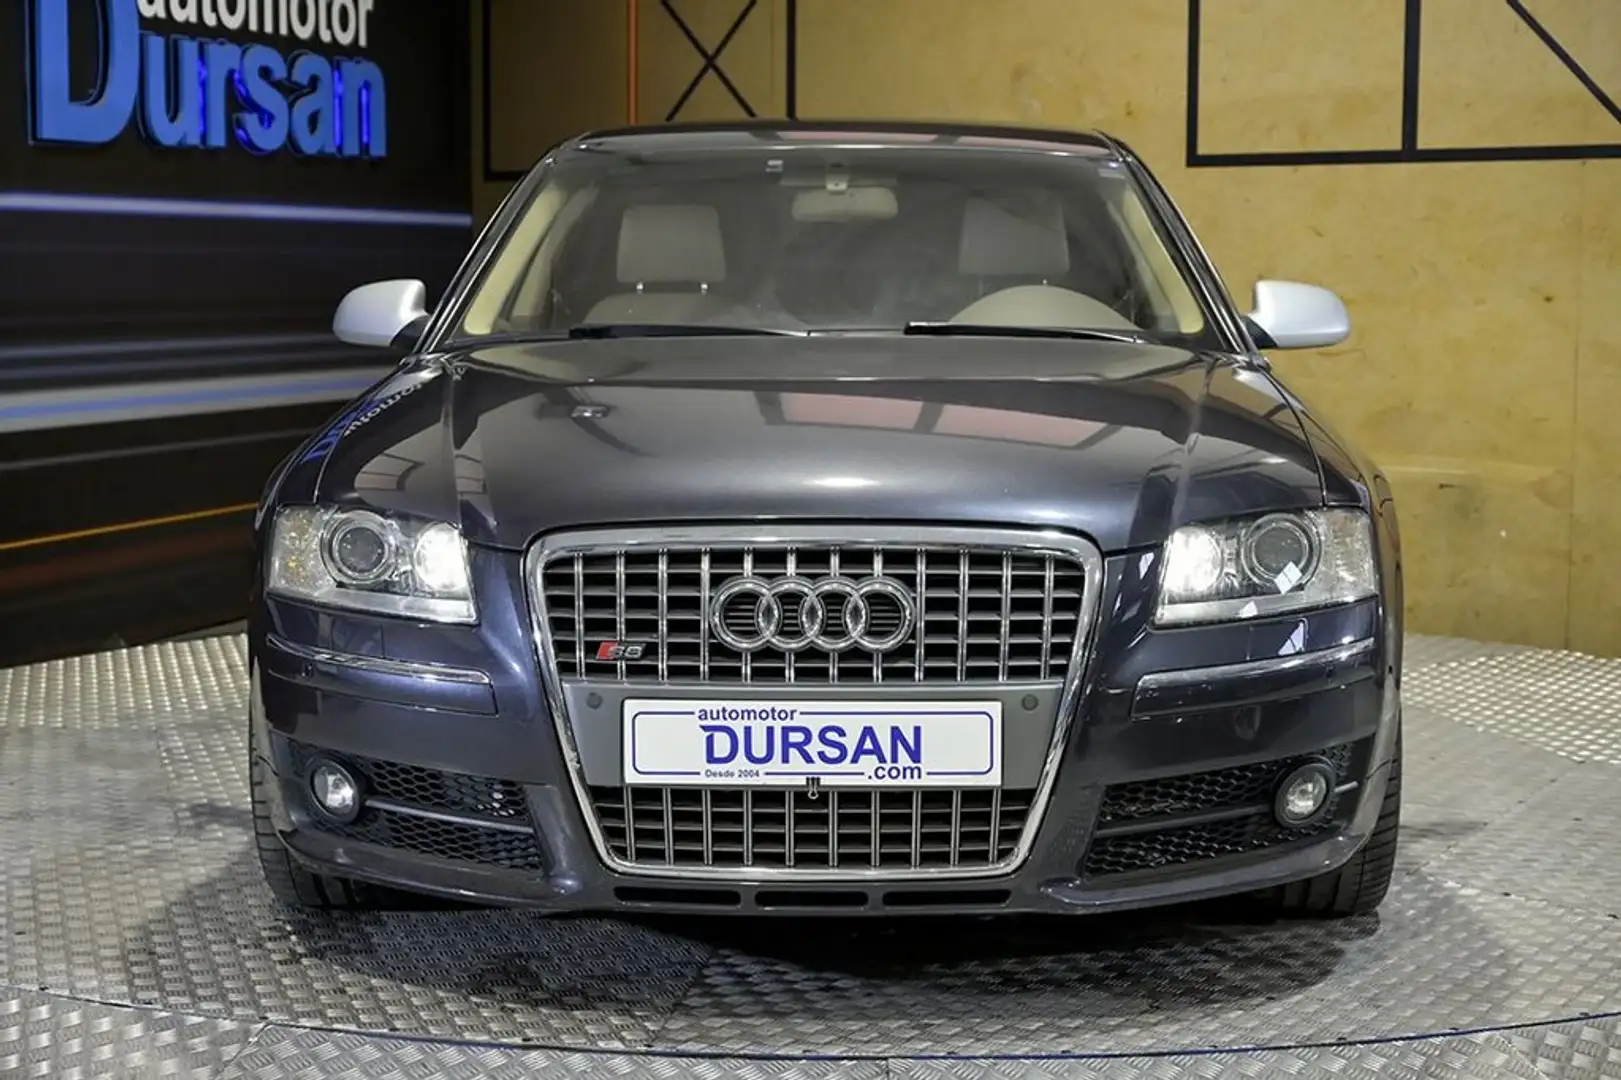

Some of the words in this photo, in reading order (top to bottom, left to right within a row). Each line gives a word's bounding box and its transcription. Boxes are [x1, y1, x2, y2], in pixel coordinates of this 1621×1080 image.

[30, 0, 387, 157] Dursan
[698, 706, 797, 721] automotor
[699, 725, 922, 764] DURSAN
[704, 769, 735, 778] Desde
[738, 769, 760, 778] 2004
[867, 765, 922, 780] .com
